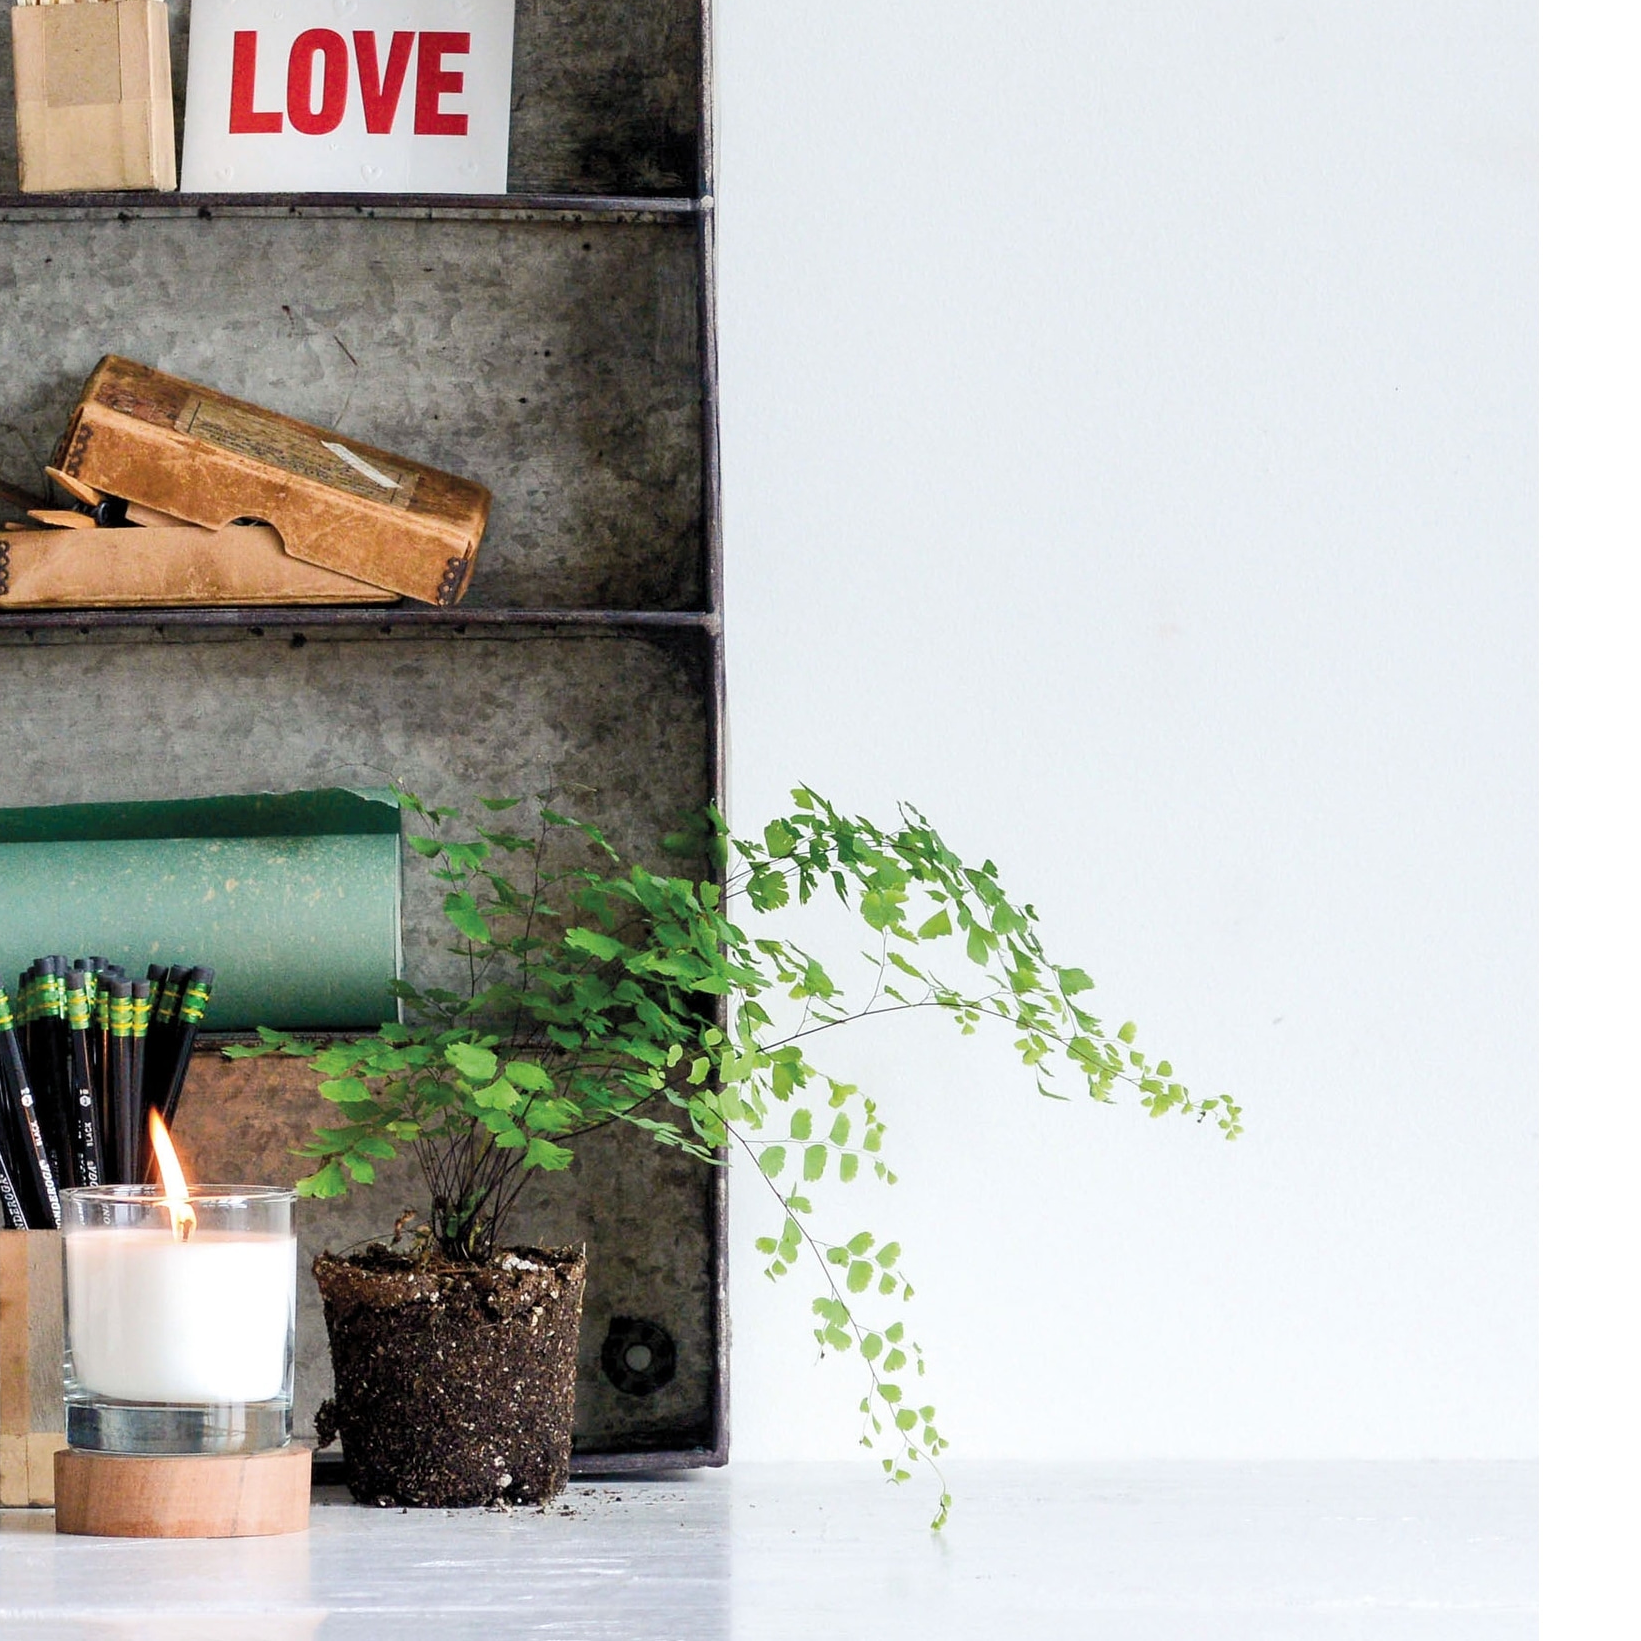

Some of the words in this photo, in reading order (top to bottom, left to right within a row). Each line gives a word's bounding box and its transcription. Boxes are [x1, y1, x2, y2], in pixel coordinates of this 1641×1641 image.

[229, 28, 470, 135] LOVE
[30, 1120, 42, 1146] BLACK
[84, 1122, 94, 1146] BLACK
